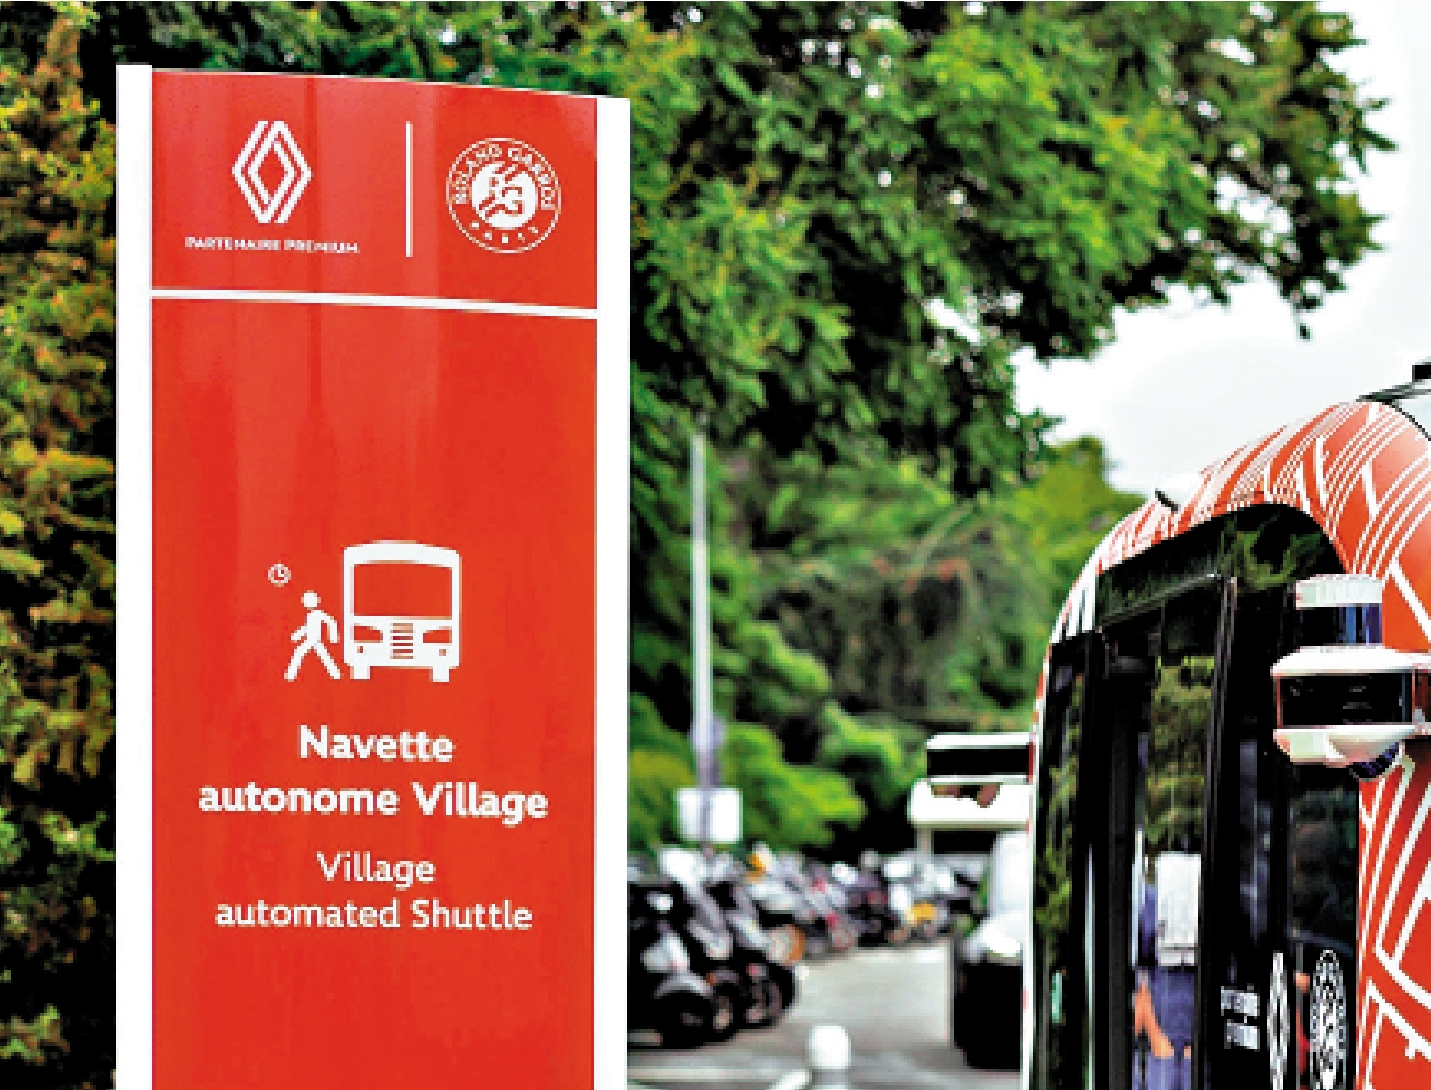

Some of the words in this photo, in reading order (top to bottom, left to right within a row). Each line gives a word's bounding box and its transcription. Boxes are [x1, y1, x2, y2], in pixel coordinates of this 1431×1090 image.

[299, 725, 454, 762] Navette
[198, 781, 400, 813] autonome
[412, 781, 549, 827] Village
[315, 851, 436, 890] Village
[214, 899, 400, 929] automated
[411, 900, 534, 930] Shuttle
